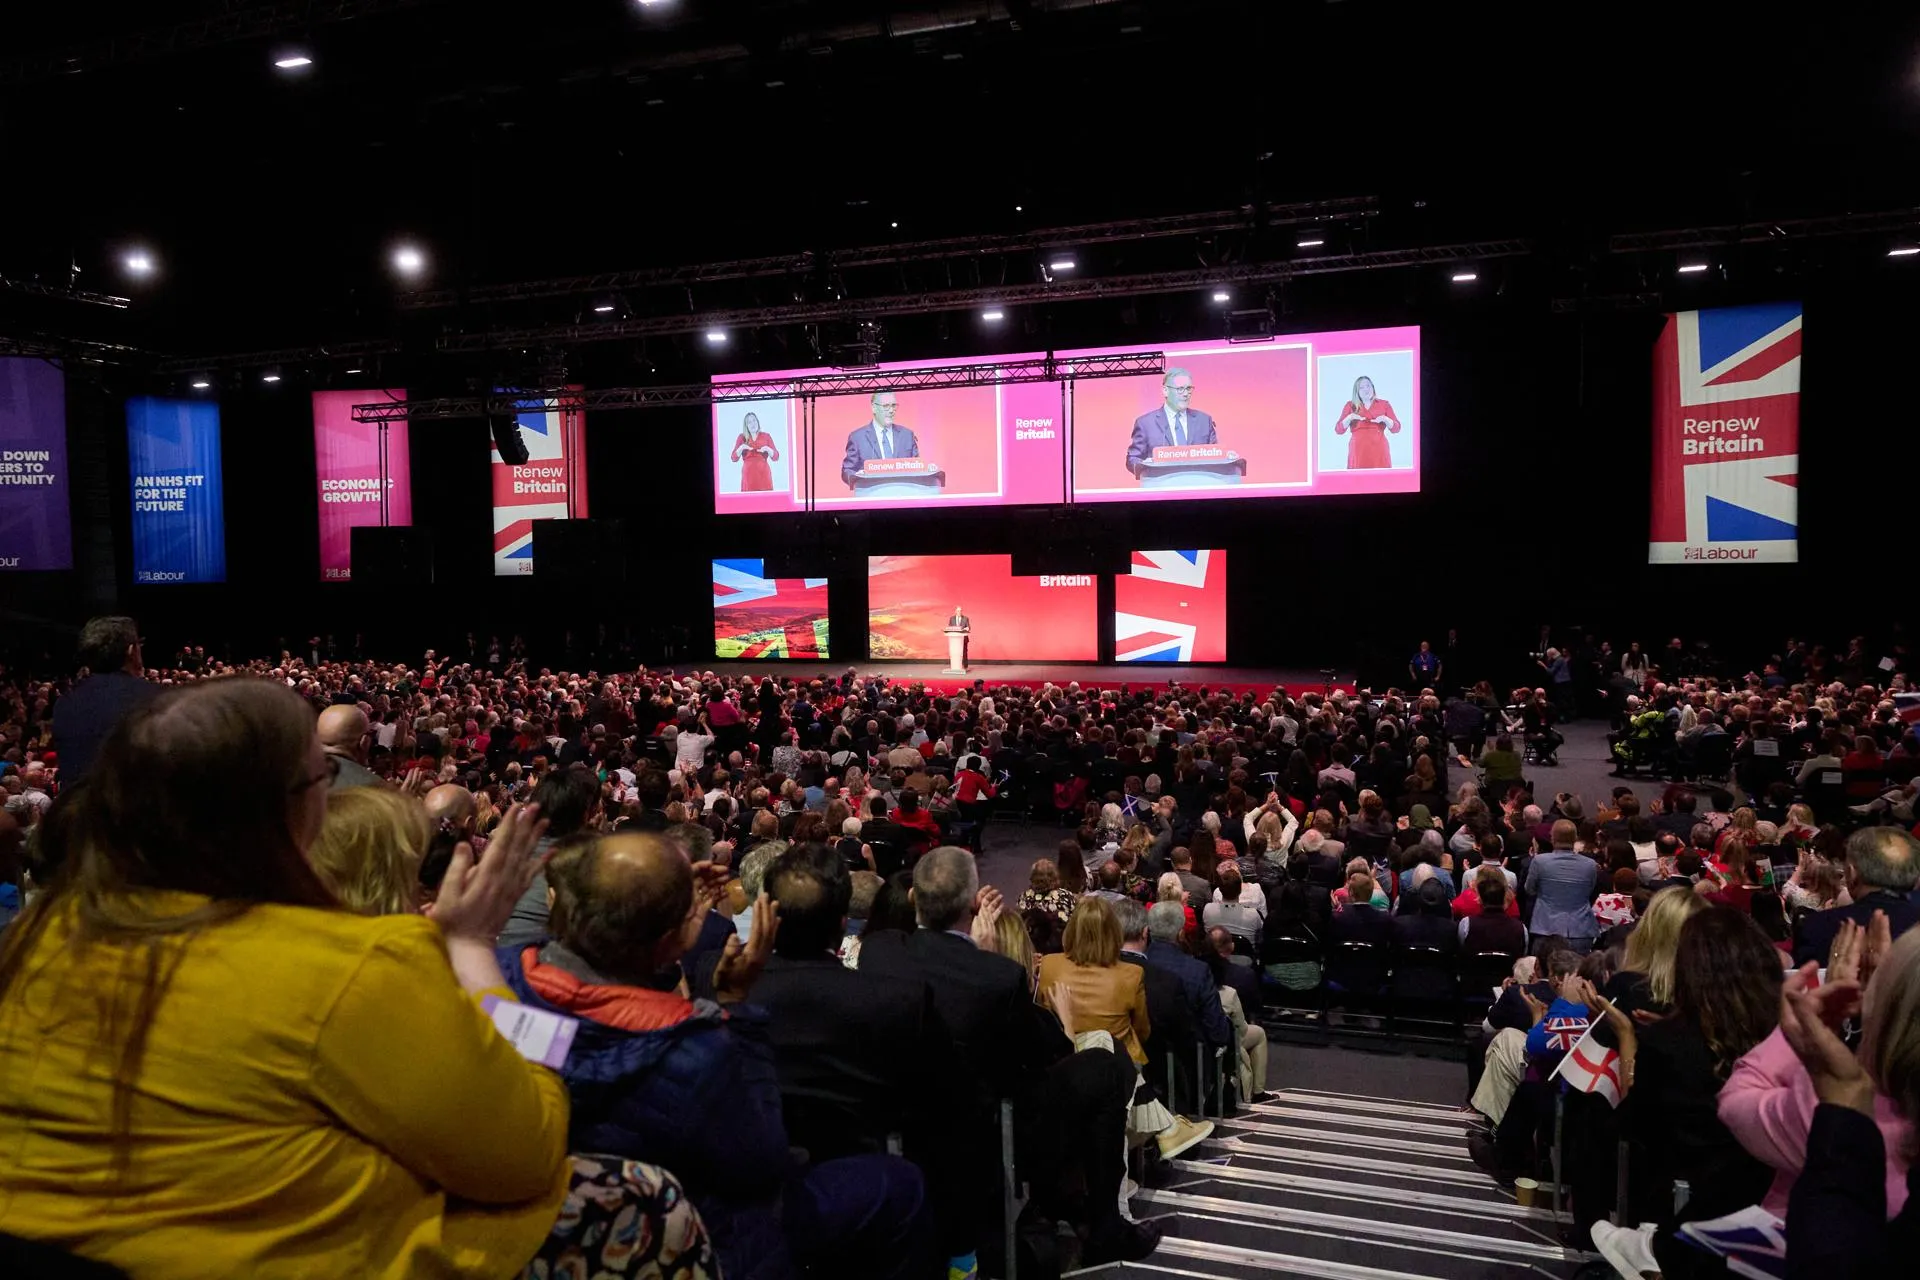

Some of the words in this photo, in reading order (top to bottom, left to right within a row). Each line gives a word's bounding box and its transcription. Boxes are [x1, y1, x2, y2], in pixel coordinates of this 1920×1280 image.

[1015, 418, 1053, 429] Renew
[1683, 417, 1760, 435] Renew
[1015, 428, 1055, 440] Britain
[1683, 434, 1764, 455] Britain
[3, 451, 50, 461] DOWN
[1158, 450, 1188, 459] Renew
[1189, 447, 1223, 457] Britain
[24, 463, 44, 473] TO
[868, 463, 895, 471] Renew
[895, 460, 924, 470] Britain
[513, 466, 563, 478] Renew
[134, 476, 154, 487] AN
[155, 476, 184, 487] NHS
[185, 475, 204, 486] FIT
[513, 479, 567, 494] Britain
[135, 489, 160, 499] FOR
[160, 488, 187, 499] THE
[322, 491, 381, 503] GROWTH
[135, 500, 184, 512] FUTURE
[1700, 547, 1758, 560] Labour
[148, 571, 185, 581] Labour
[1039, 574, 1092, 587] Britain
